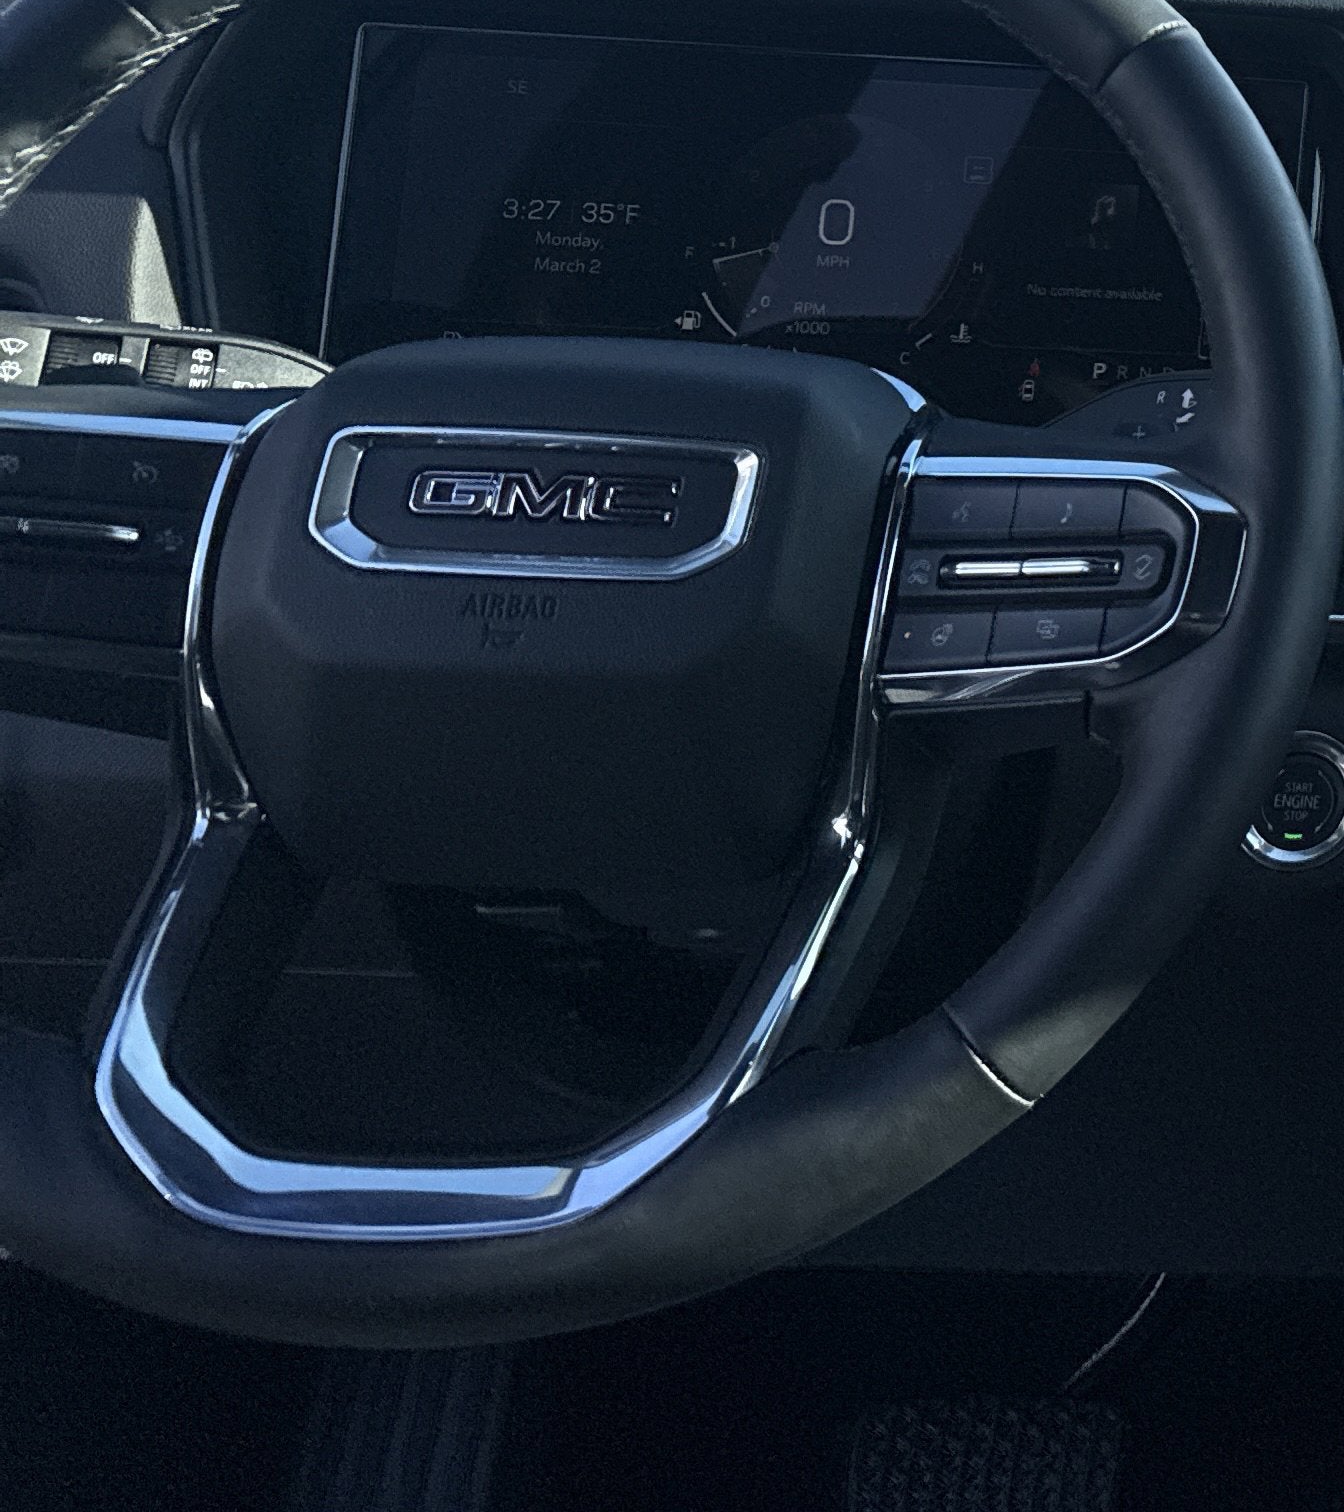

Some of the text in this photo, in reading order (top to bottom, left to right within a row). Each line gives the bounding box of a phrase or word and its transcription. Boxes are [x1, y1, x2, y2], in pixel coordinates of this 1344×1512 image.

[502, 198, 642, 225] 3:27 35°F
[818, 199, 855, 246] 0
[534, 257, 601, 274] March 2
[816, 254, 850, 269] MPH
[972, 261, 984, 275] H
[793, 301, 827, 316] RPM
[92, 351, 116, 366] OFF
[189, 363, 212, 376] OFF
[1092, 362, 1107, 380] P
[1115, 365, 1129, 381] R
[408, 470, 685, 526] GMC
[1284, 783, 1313, 793] START
[1274, 794, 1320, 810] ENGINE
[1283, 811, 1308, 822] STOP
